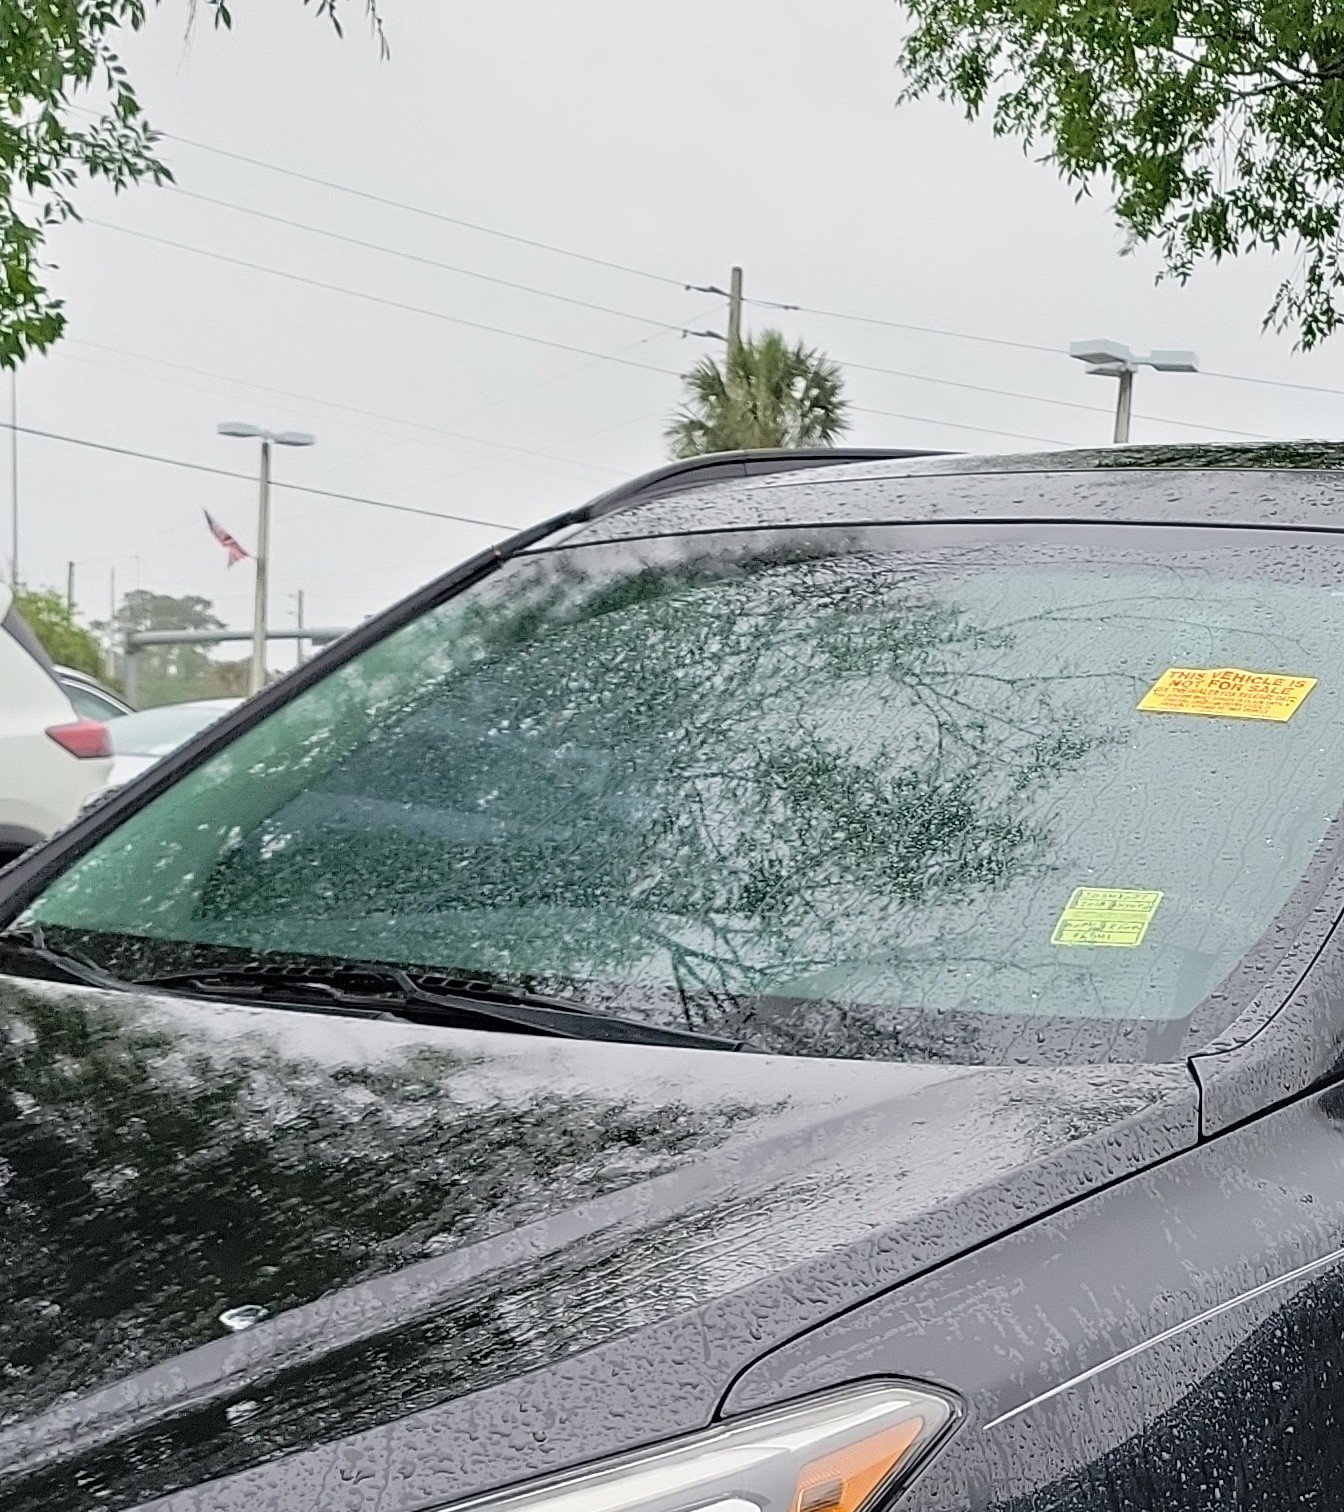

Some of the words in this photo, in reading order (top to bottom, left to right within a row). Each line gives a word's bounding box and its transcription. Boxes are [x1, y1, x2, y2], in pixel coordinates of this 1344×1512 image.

[1168, 679, 1205, 688] NOT
[1207, 679, 1242, 691] FOR
[1247, 685, 1294, 695] SALE
[1169, 671, 1204, 681] THIS
[1212, 670, 1285, 687] VEHICLE
[1290, 679, 1306, 688] IS
